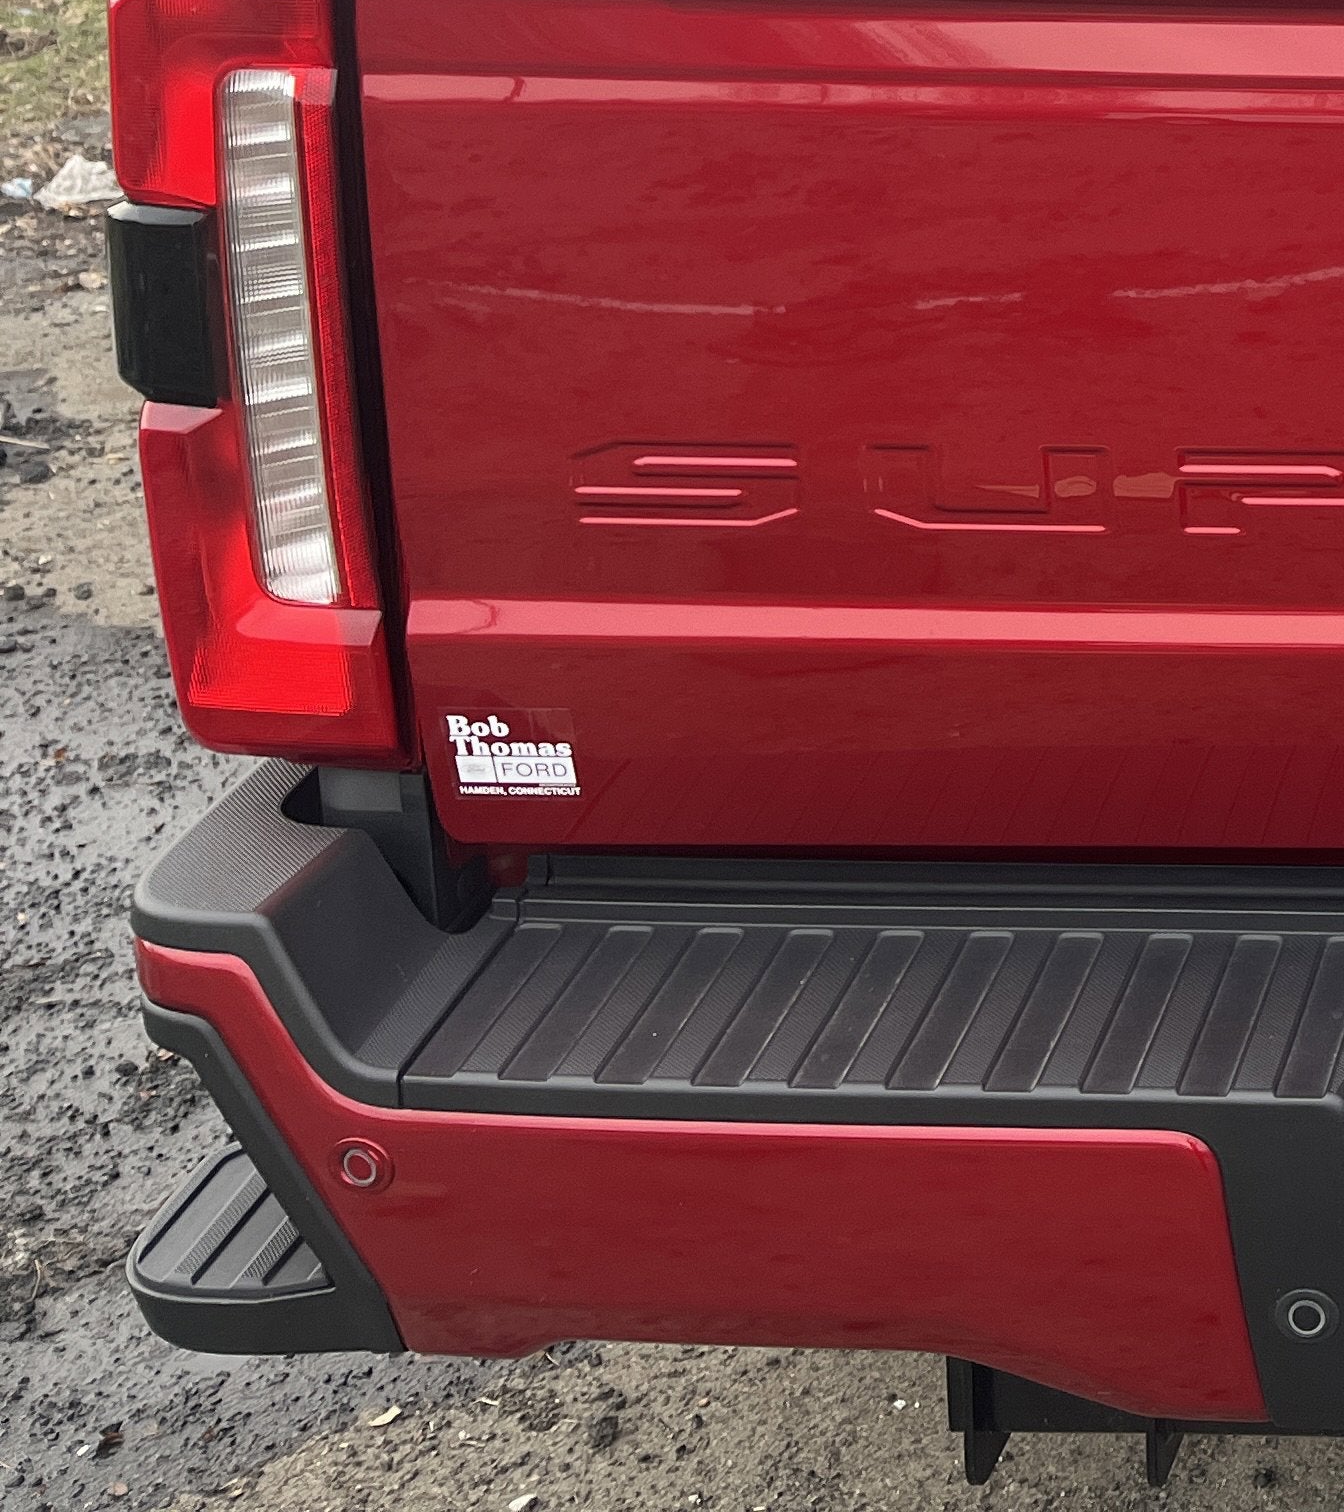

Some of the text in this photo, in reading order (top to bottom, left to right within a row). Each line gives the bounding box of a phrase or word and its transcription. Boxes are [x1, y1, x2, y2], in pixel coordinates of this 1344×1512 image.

[446, 714, 510, 738] Bob
[449, 735, 573, 757] Thomas
[501, 762, 568, 777] FORD
[508, 786, 581, 796] CONNECTICUT
